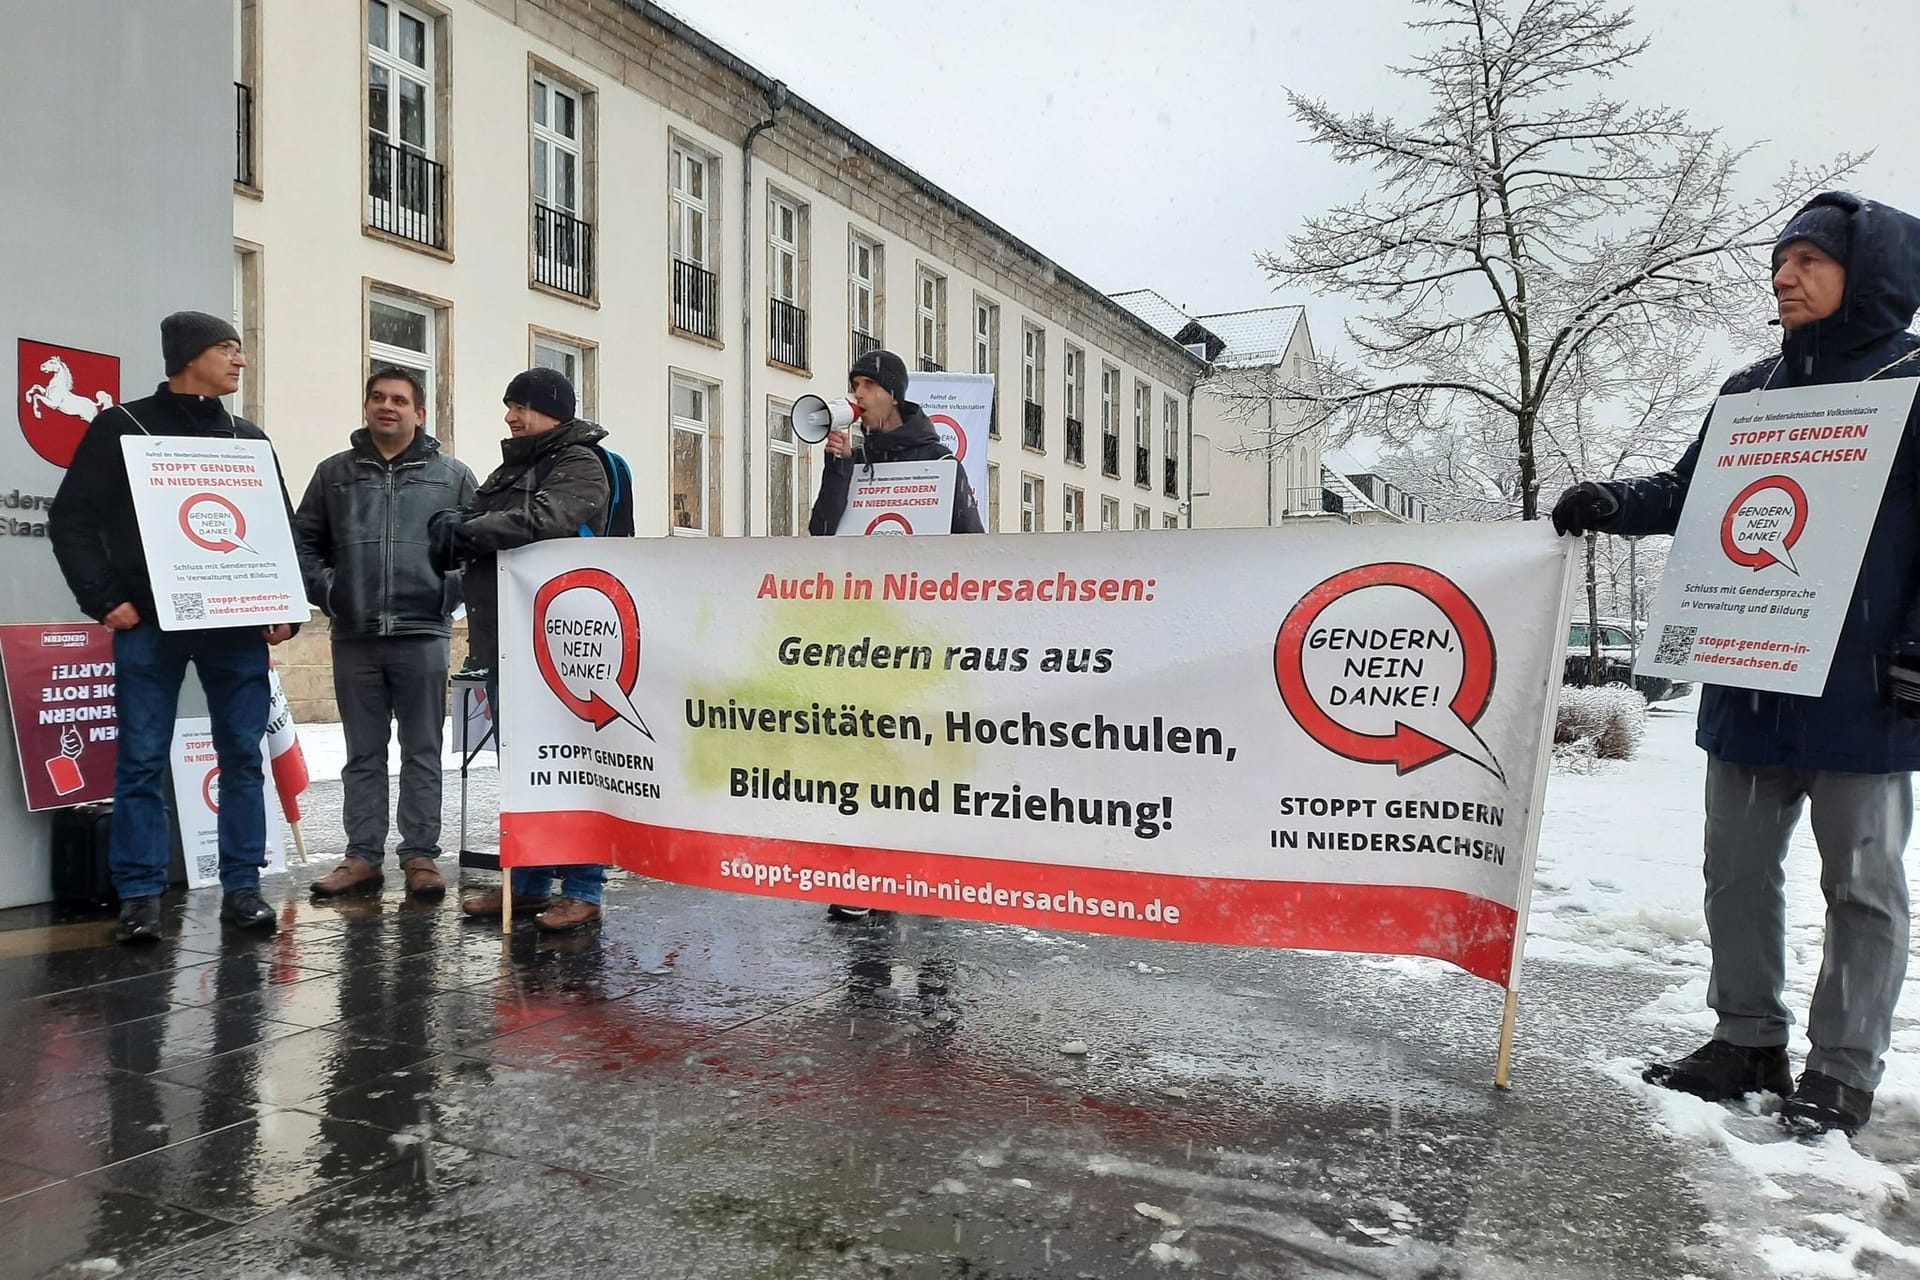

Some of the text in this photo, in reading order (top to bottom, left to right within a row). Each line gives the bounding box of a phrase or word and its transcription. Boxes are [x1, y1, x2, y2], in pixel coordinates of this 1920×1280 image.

[1732, 406, 1878, 425] Aufruf der Niedersächsischen Volksinitiative
[1730, 424, 1869, 446] STOPPT GENDERN
[1717, 448, 1868, 467] IN NIEDERSACHSEN
[152, 462, 255, 473] STOPPT GENDERN
[150, 477, 263, 487] IN NIEDERSACHSEN
[858, 484, 937, 495] STOPPT GENDERN
[852, 498, 939, 508] IN NIEDERSACHSEN
[1738, 506, 1793, 517] GENDERN,
[1747, 519, 1779, 528] NEIN
[1738, 532, 1781, 542] DANKE!
[220, 562, 276, 571] Gendersprache
[186, 574, 232, 582] Verwaltung
[234, 572, 248, 580] und
[250, 571, 278, 580] Bildung
[757, 572, 1157, 602] Auch in Niedersachsen:
[1684, 584, 1816, 599] Schluss mit Gendersprache
[207, 592, 292, 605] stoppt-gendern-in-
[209, 604, 289, 615] niedersachsen.de
[1680, 600, 1810, 618] in Verwaltung und Bildung
[546, 620, 618, 638] GENDERN,
[563, 642, 602, 657] NEIN
[1309, 628, 1455, 653] GENDERN,
[1698, 635, 1810, 654] stoppt-gendern-in-
[778, 636, 1113, 674] Gendern raus aus
[1693, 652, 1798, 672] niedersachsen.de
[52, 662, 116, 680] KARTE!
[561, 663, 612, 680] DANKE!
[1344, 657, 1424, 678] NEIN
[42, 686, 89, 702] ROTE
[1329, 686, 1440, 707] DANKE!
[685, 698, 1237, 762] Universitäten, Hochschulen,
[538, 744, 654, 771] STOPPT GENDERN
[530, 770, 660, 798] IN NIEDERSACHSEN
[730, 767, 1173, 838] Bildung und Erziehung!
[1280, 796, 1504, 827] STOPPT GENDERN
[1271, 830, 1505, 866] IN NIEDERSACHSEN
[720, 859, 1180, 924] stoppt-gendern-in-niedersachsen.de
